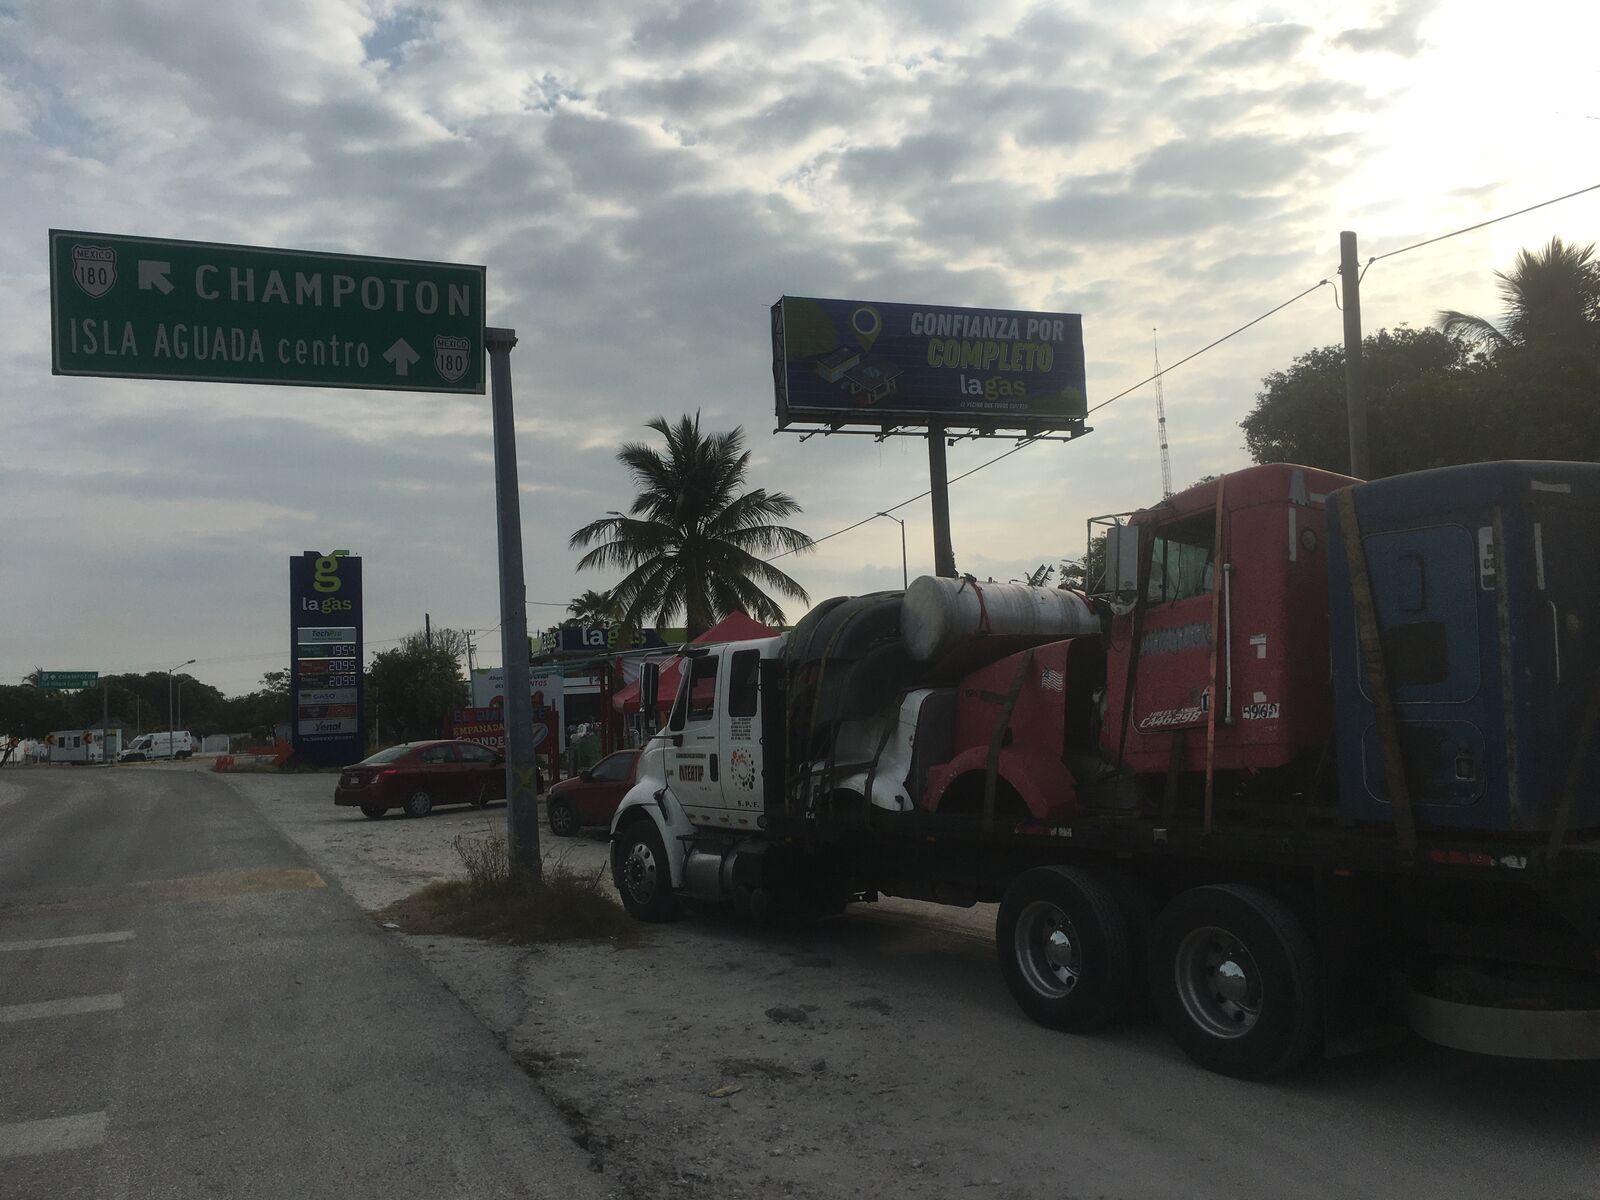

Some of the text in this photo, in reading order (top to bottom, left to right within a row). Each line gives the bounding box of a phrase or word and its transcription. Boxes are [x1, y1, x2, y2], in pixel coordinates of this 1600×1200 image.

[76, 249, 112, 260] MEXICO
[80, 266, 107, 286] 180
[195, 264, 471, 317] CHAMPOTON
[911, 311, 1065, 342] CONFIANZA POR
[71, 318, 369, 368] ISLA AGUADA centro
[436, 339, 467, 349] MEXICO
[927, 337, 1054, 373] COMPLETO
[440, 354, 463, 371] 180
